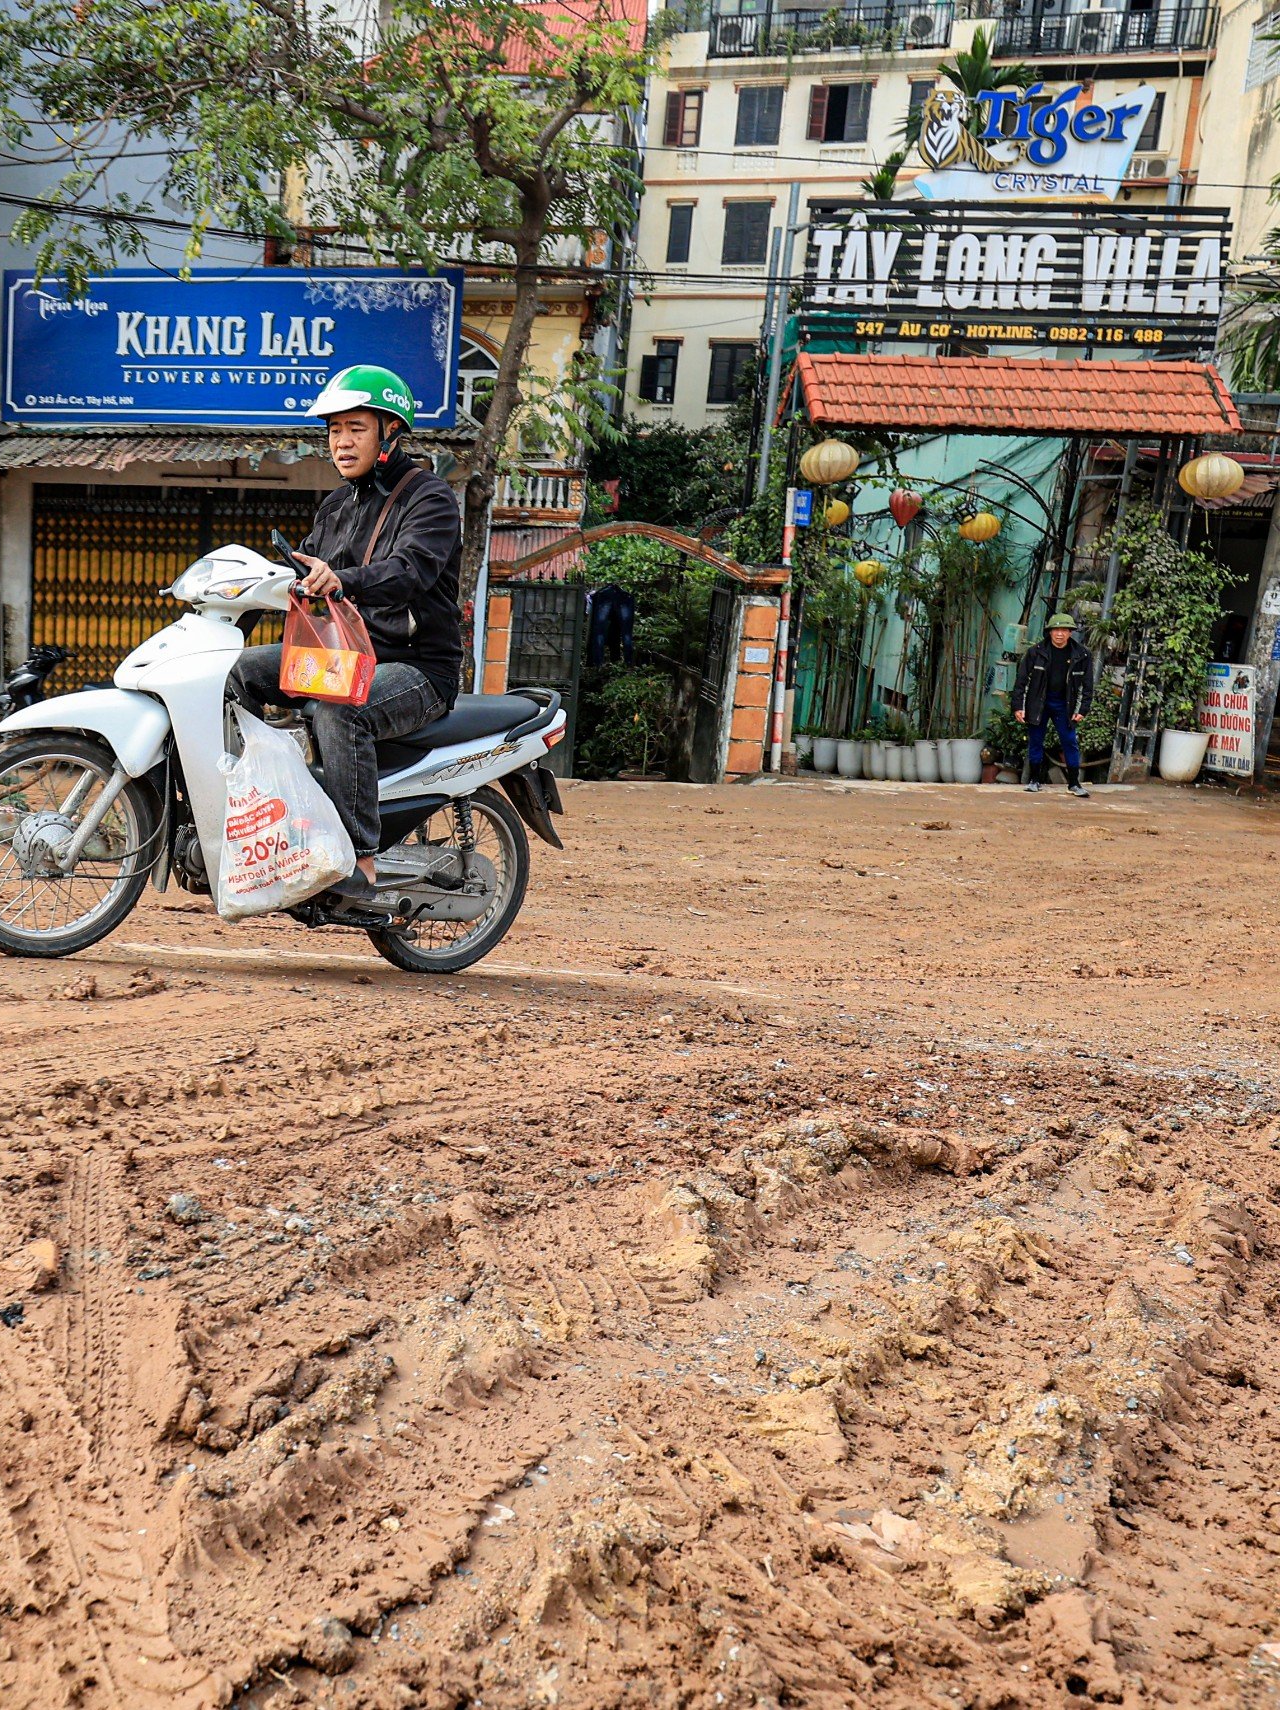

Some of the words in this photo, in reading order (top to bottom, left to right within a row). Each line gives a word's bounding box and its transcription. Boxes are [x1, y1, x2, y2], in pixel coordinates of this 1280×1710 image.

[975, 82, 1143, 166] Tiger
[993, 172, 1106, 193] CRYSTAL
[811, 212, 903, 307] TÂY
[915, 232, 1058, 311] LONG
[1080, 234, 1221, 315] VILLA
[115, 311, 247, 358] KHANG
[258, 311, 335, 364] LẠC
[856, 321, 884, 335] 347
[899, 320, 921, 337] ÂU
[929, 323, 951, 338] CƠ
[966, 324, 1038, 339] HOTLINE:
[1049, 327, 1088, 341] 0982
[1096, 328, 1123, 342] 116
[1134, 329, 1163, 342] 488
[123, 370, 205, 384] FLOWER
[210, 371, 222, 384] &
[227, 370, 328, 385] WEDDING
[38, 395, 55, 404] 343
[119, 396, 134, 404] HN
[382, 387, 412, 412] Grab
[242, 832, 289, 867] 20%
[275, 848, 311, 869] WinEco
